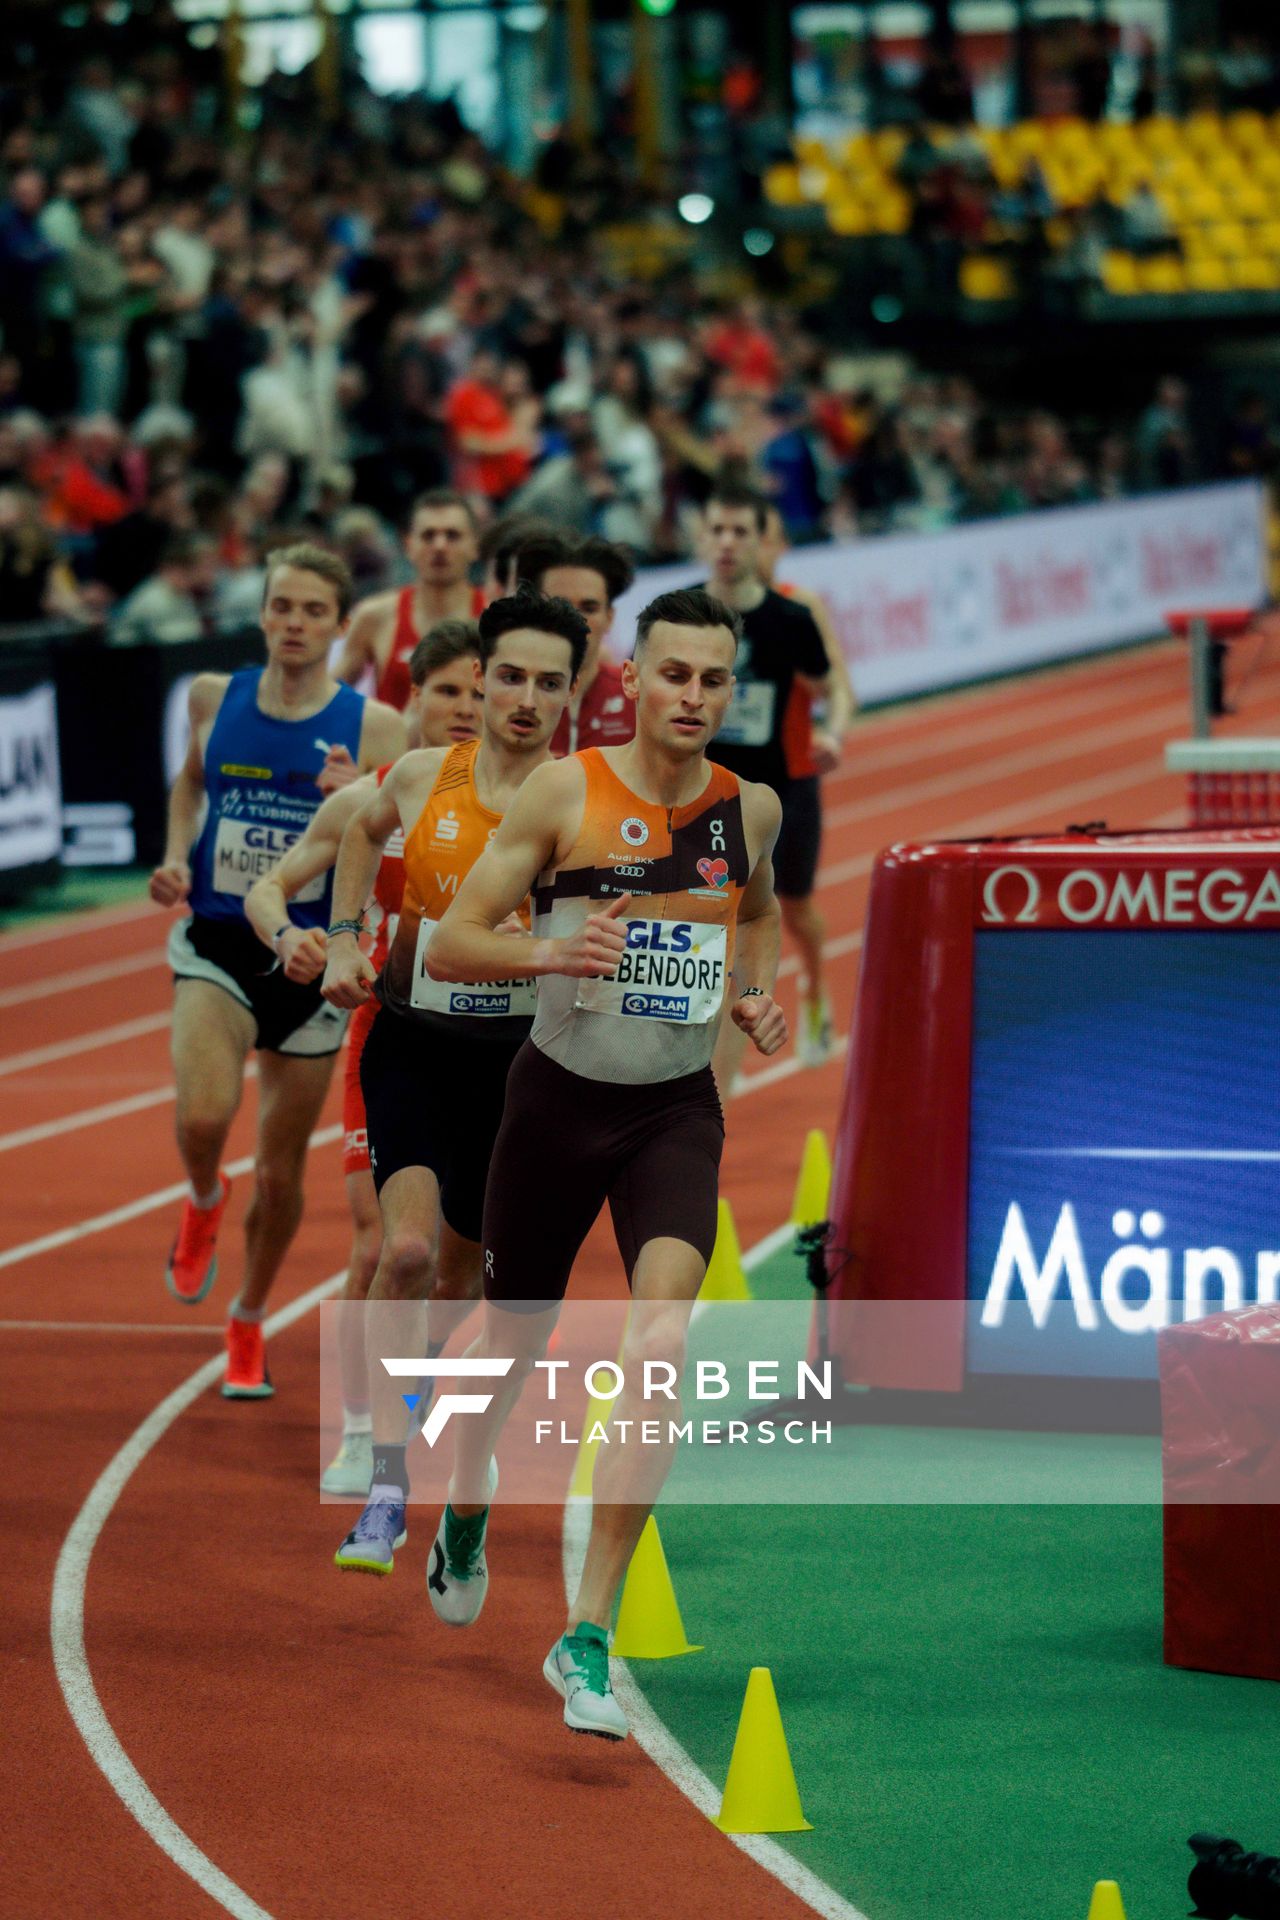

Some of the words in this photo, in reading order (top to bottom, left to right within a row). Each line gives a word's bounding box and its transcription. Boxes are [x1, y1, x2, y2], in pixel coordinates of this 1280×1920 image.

[244, 827, 300, 850] GLS
[607, 852, 632, 862] Audi
[634, 855, 655, 865] BKK
[1058, 869, 1280, 923] OMEGA
[625, 920, 692, 953] GLS
[588, 953, 722, 991] BENDORF
[475, 998, 508, 1007] PLAN
[650, 999, 686, 1012] PLAN
